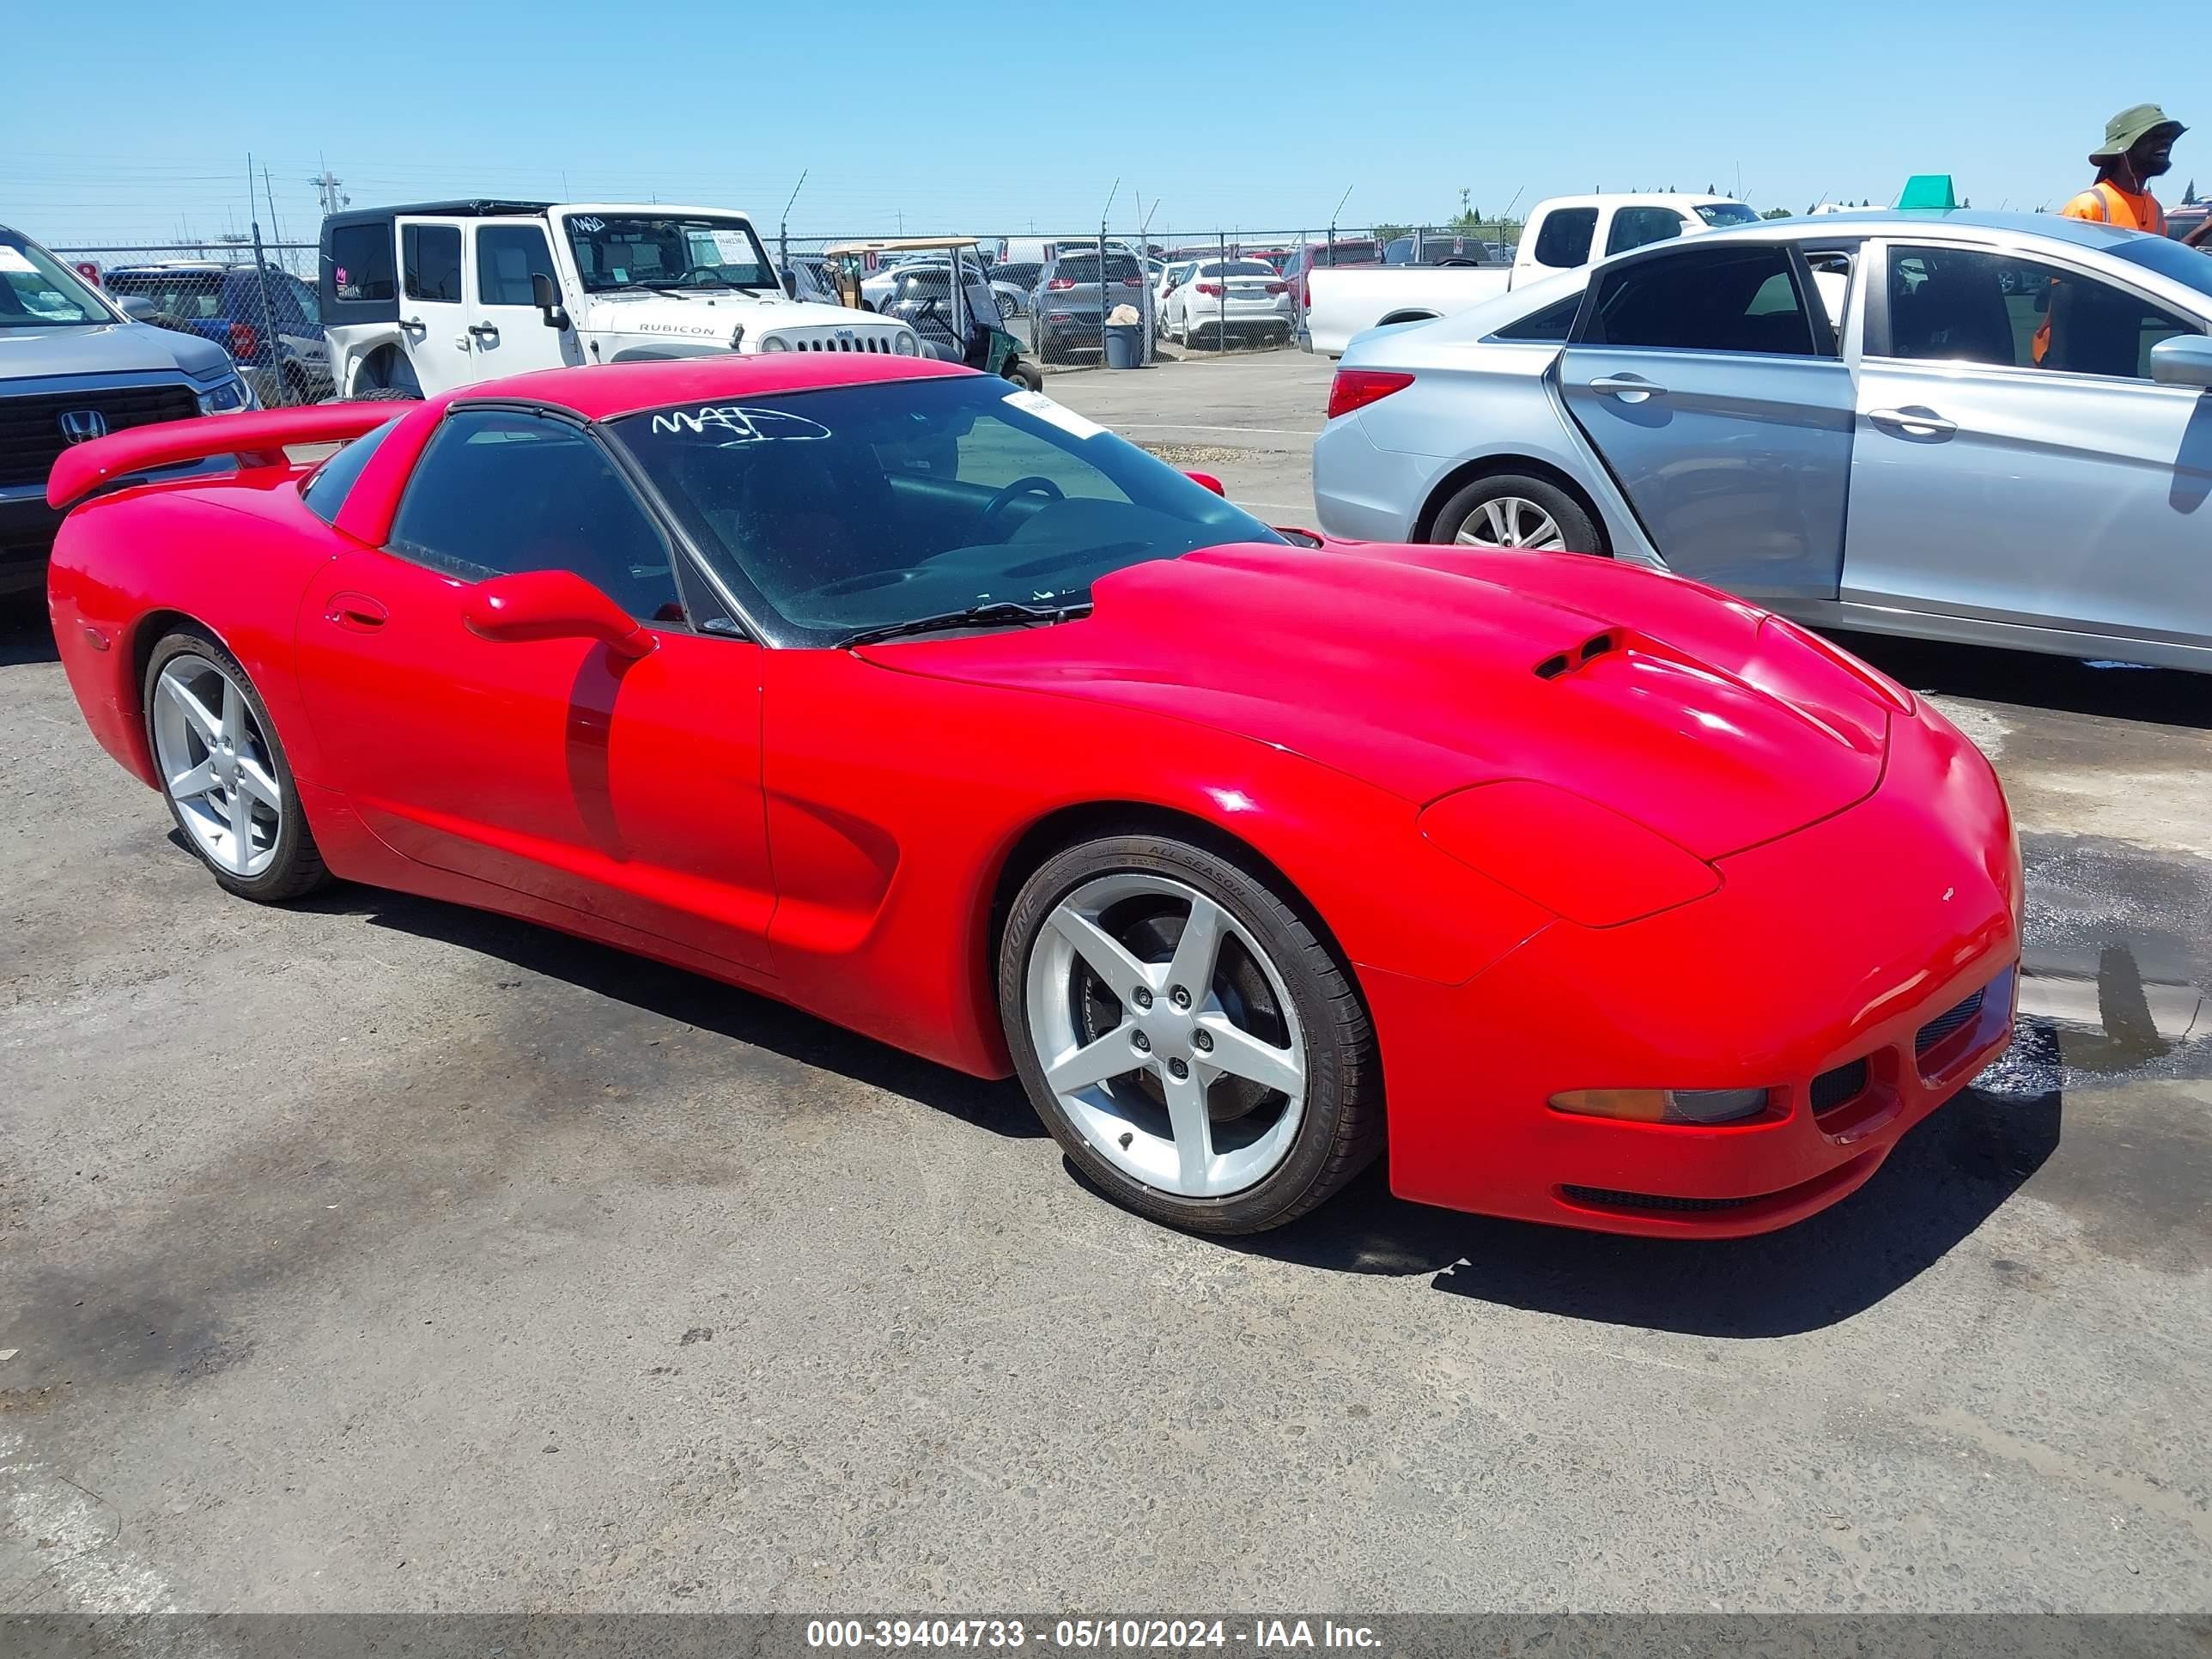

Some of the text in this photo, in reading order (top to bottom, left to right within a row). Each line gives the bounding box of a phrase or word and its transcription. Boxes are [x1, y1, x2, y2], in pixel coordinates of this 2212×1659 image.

[571, 216, 605, 232] MAD
[864, 252, 878, 270] 10
[1043, 245, 1056, 262] 11
[1230, 244, 1240, 258] 12
[76, 263, 100, 288] 8
[640, 323, 714, 336] RUBICON
[653, 407, 831, 448] MAD
[214, 647, 252, 694] VIENTO
[1148, 846, 1177, 858] ALL
[1182, 856, 1246, 896] SEASON
[1004, 894, 1036, 1023] FORTUNE
[1313, 1050, 1334, 1150] VIENTO
